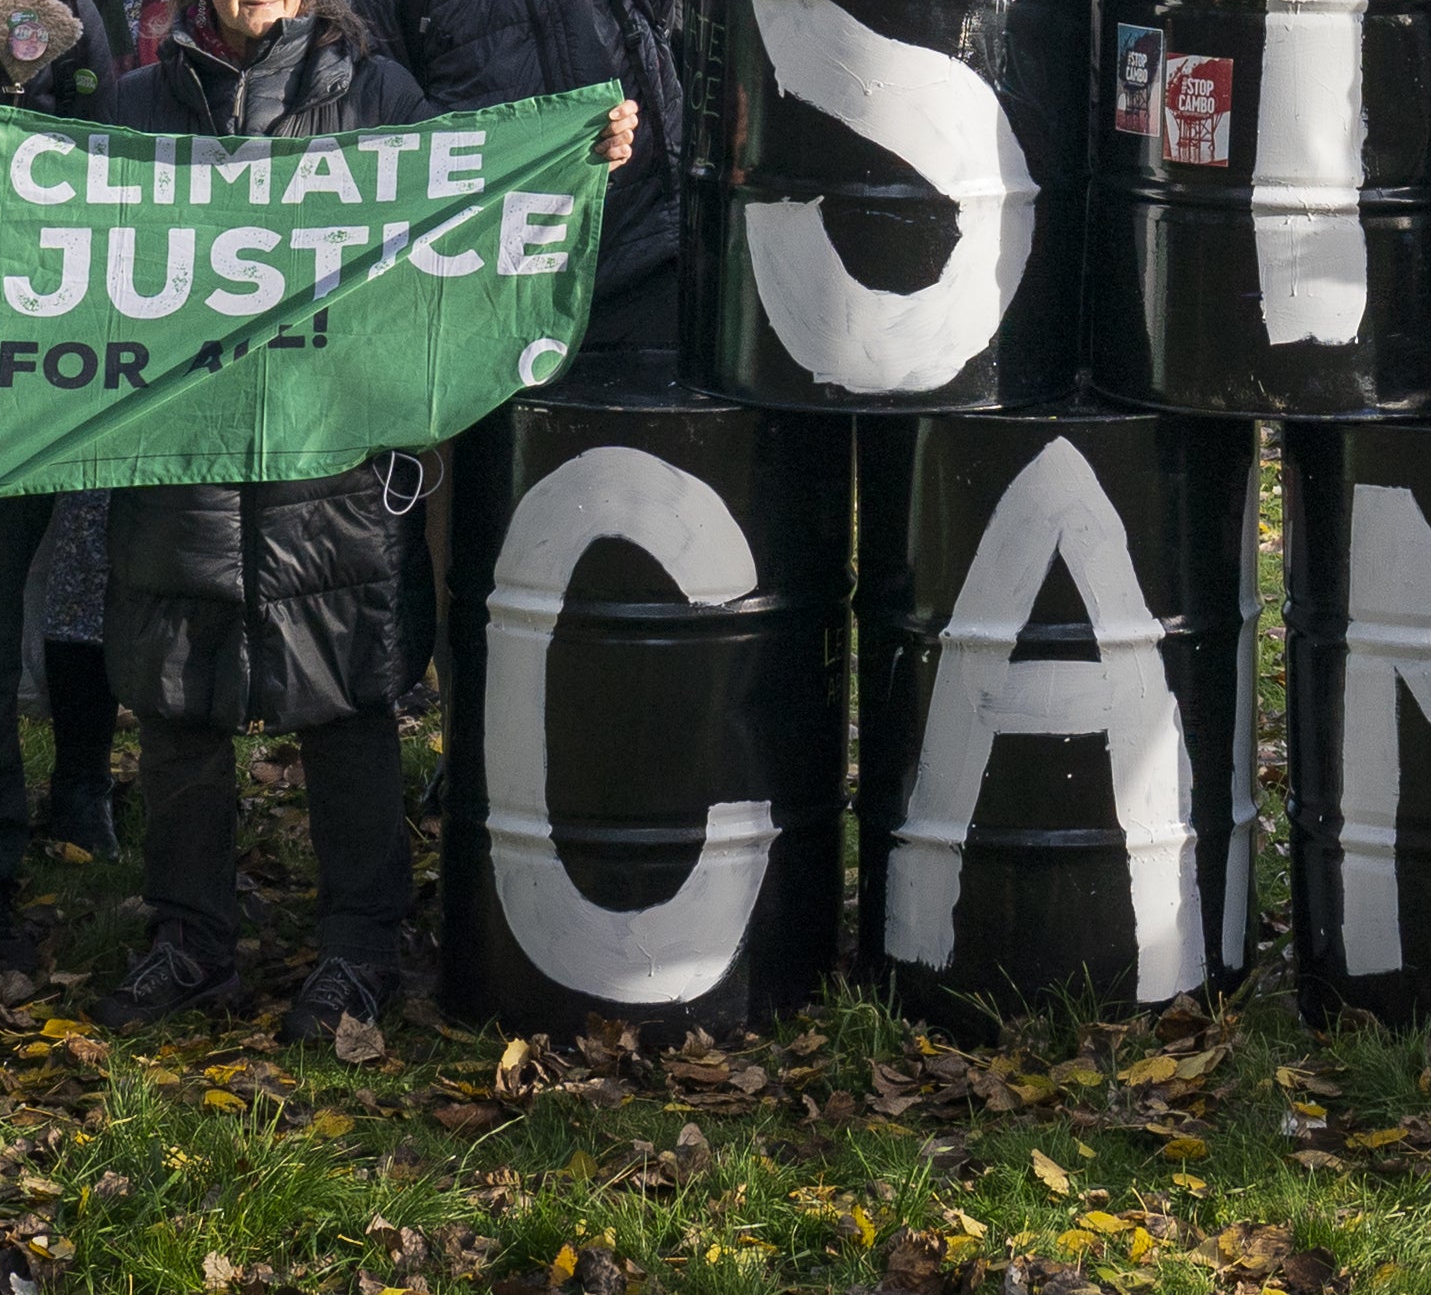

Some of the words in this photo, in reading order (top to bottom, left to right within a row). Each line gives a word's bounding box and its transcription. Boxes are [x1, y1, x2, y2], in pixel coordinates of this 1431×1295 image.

[1178, 94, 1216, 115] CAMBO
[10, 130, 486, 205] CLIMATE
[3, 191, 574, 321] JUSTICE
